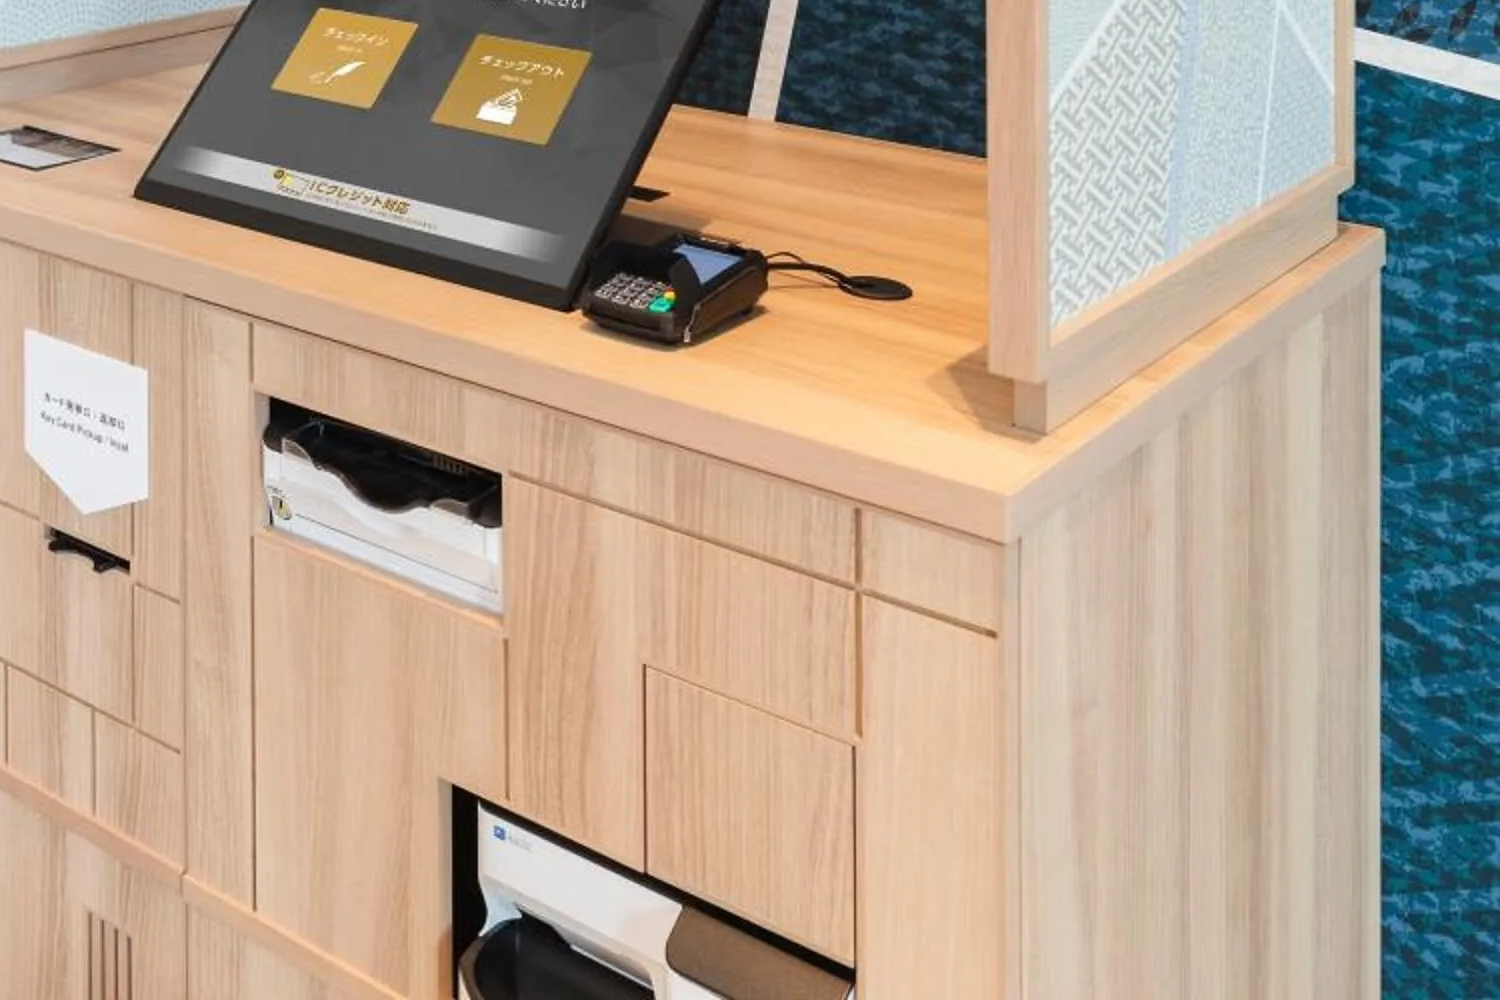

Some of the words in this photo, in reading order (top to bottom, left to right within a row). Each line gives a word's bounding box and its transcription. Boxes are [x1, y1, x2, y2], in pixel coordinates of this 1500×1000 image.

[322, 26, 390, 47] チェックイン
[478, 55, 565, 79] チェックアウト
[309, 179, 411, 215] ICクレジット対応
